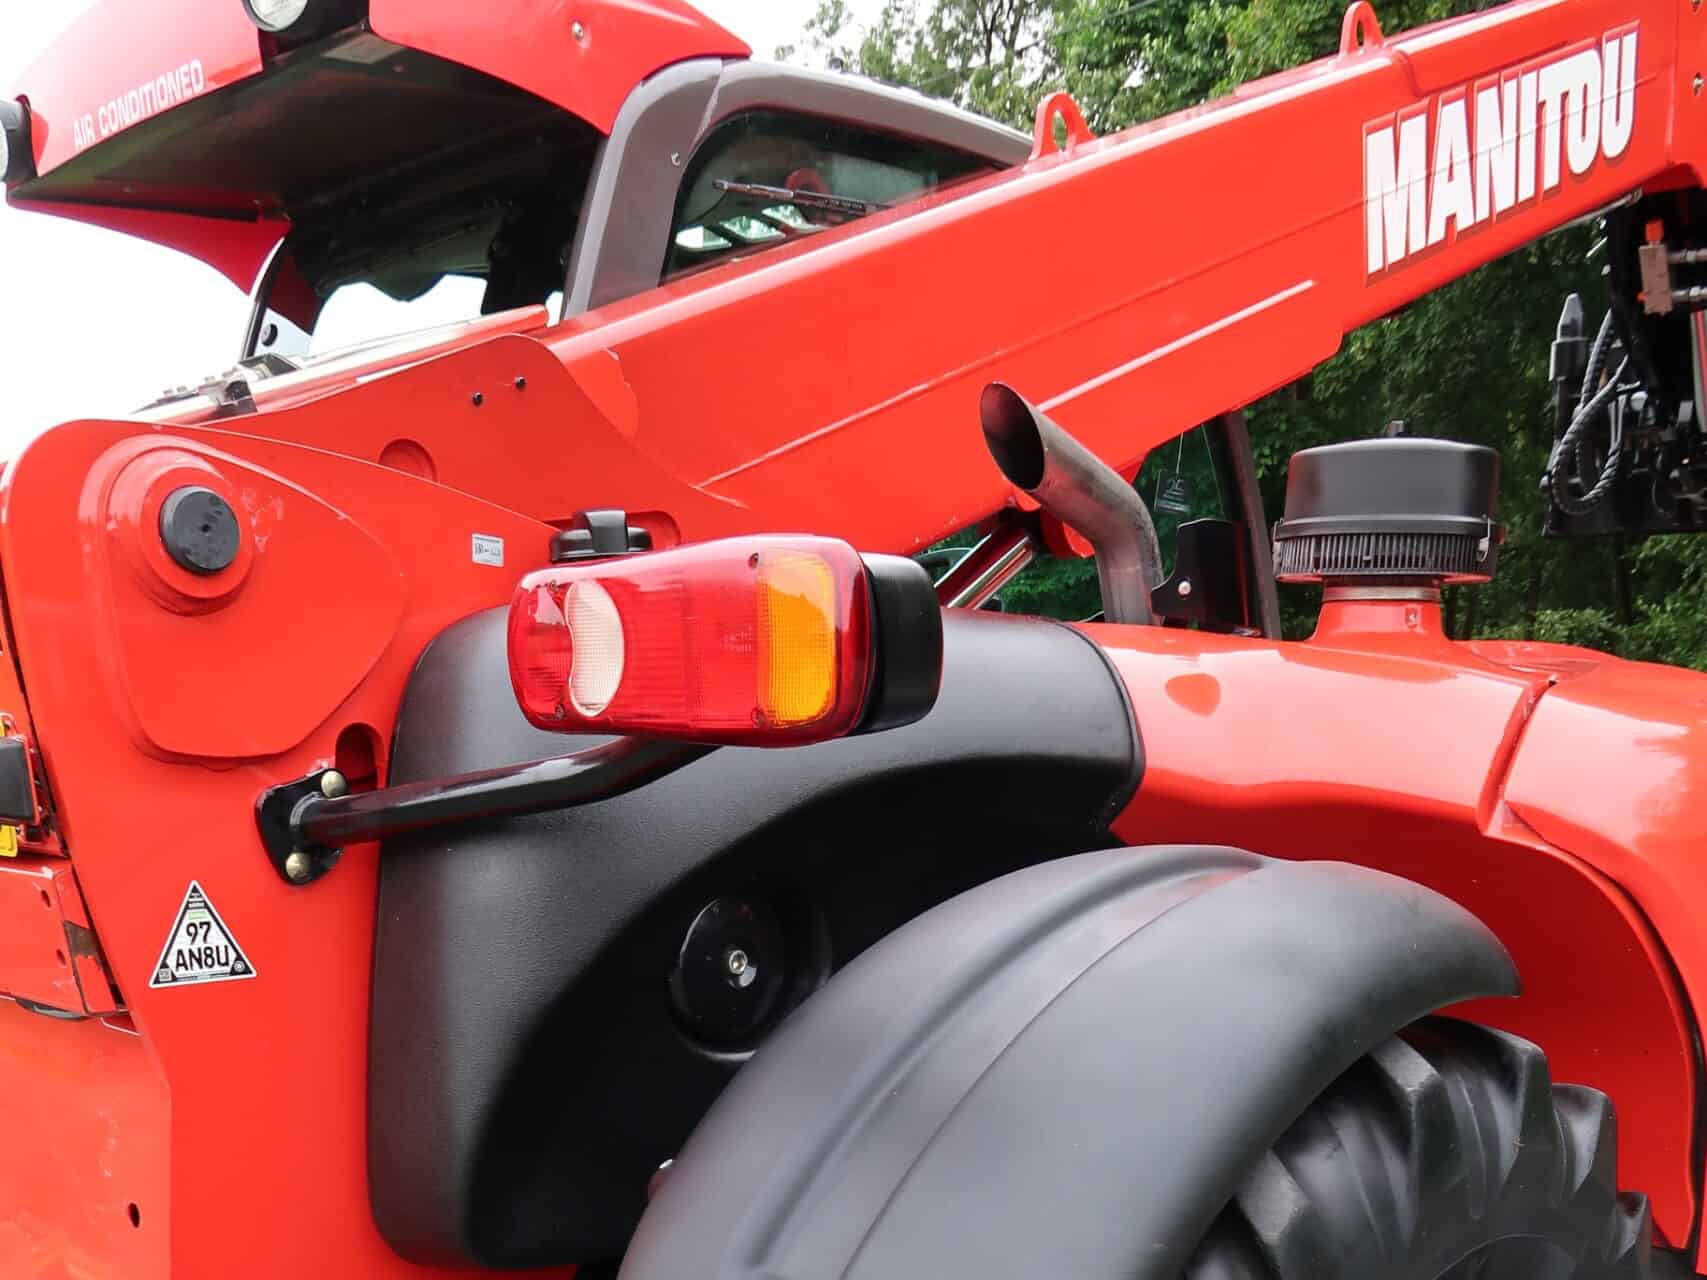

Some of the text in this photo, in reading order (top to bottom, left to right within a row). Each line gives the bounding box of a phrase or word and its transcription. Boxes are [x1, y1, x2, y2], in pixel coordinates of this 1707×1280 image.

[72, 58, 205, 149] AIR CONDITIONED
[1365, 30, 1639, 275] MANITOU
[175, 944, 230, 972] AN8U
[186, 920, 211, 945] 97
